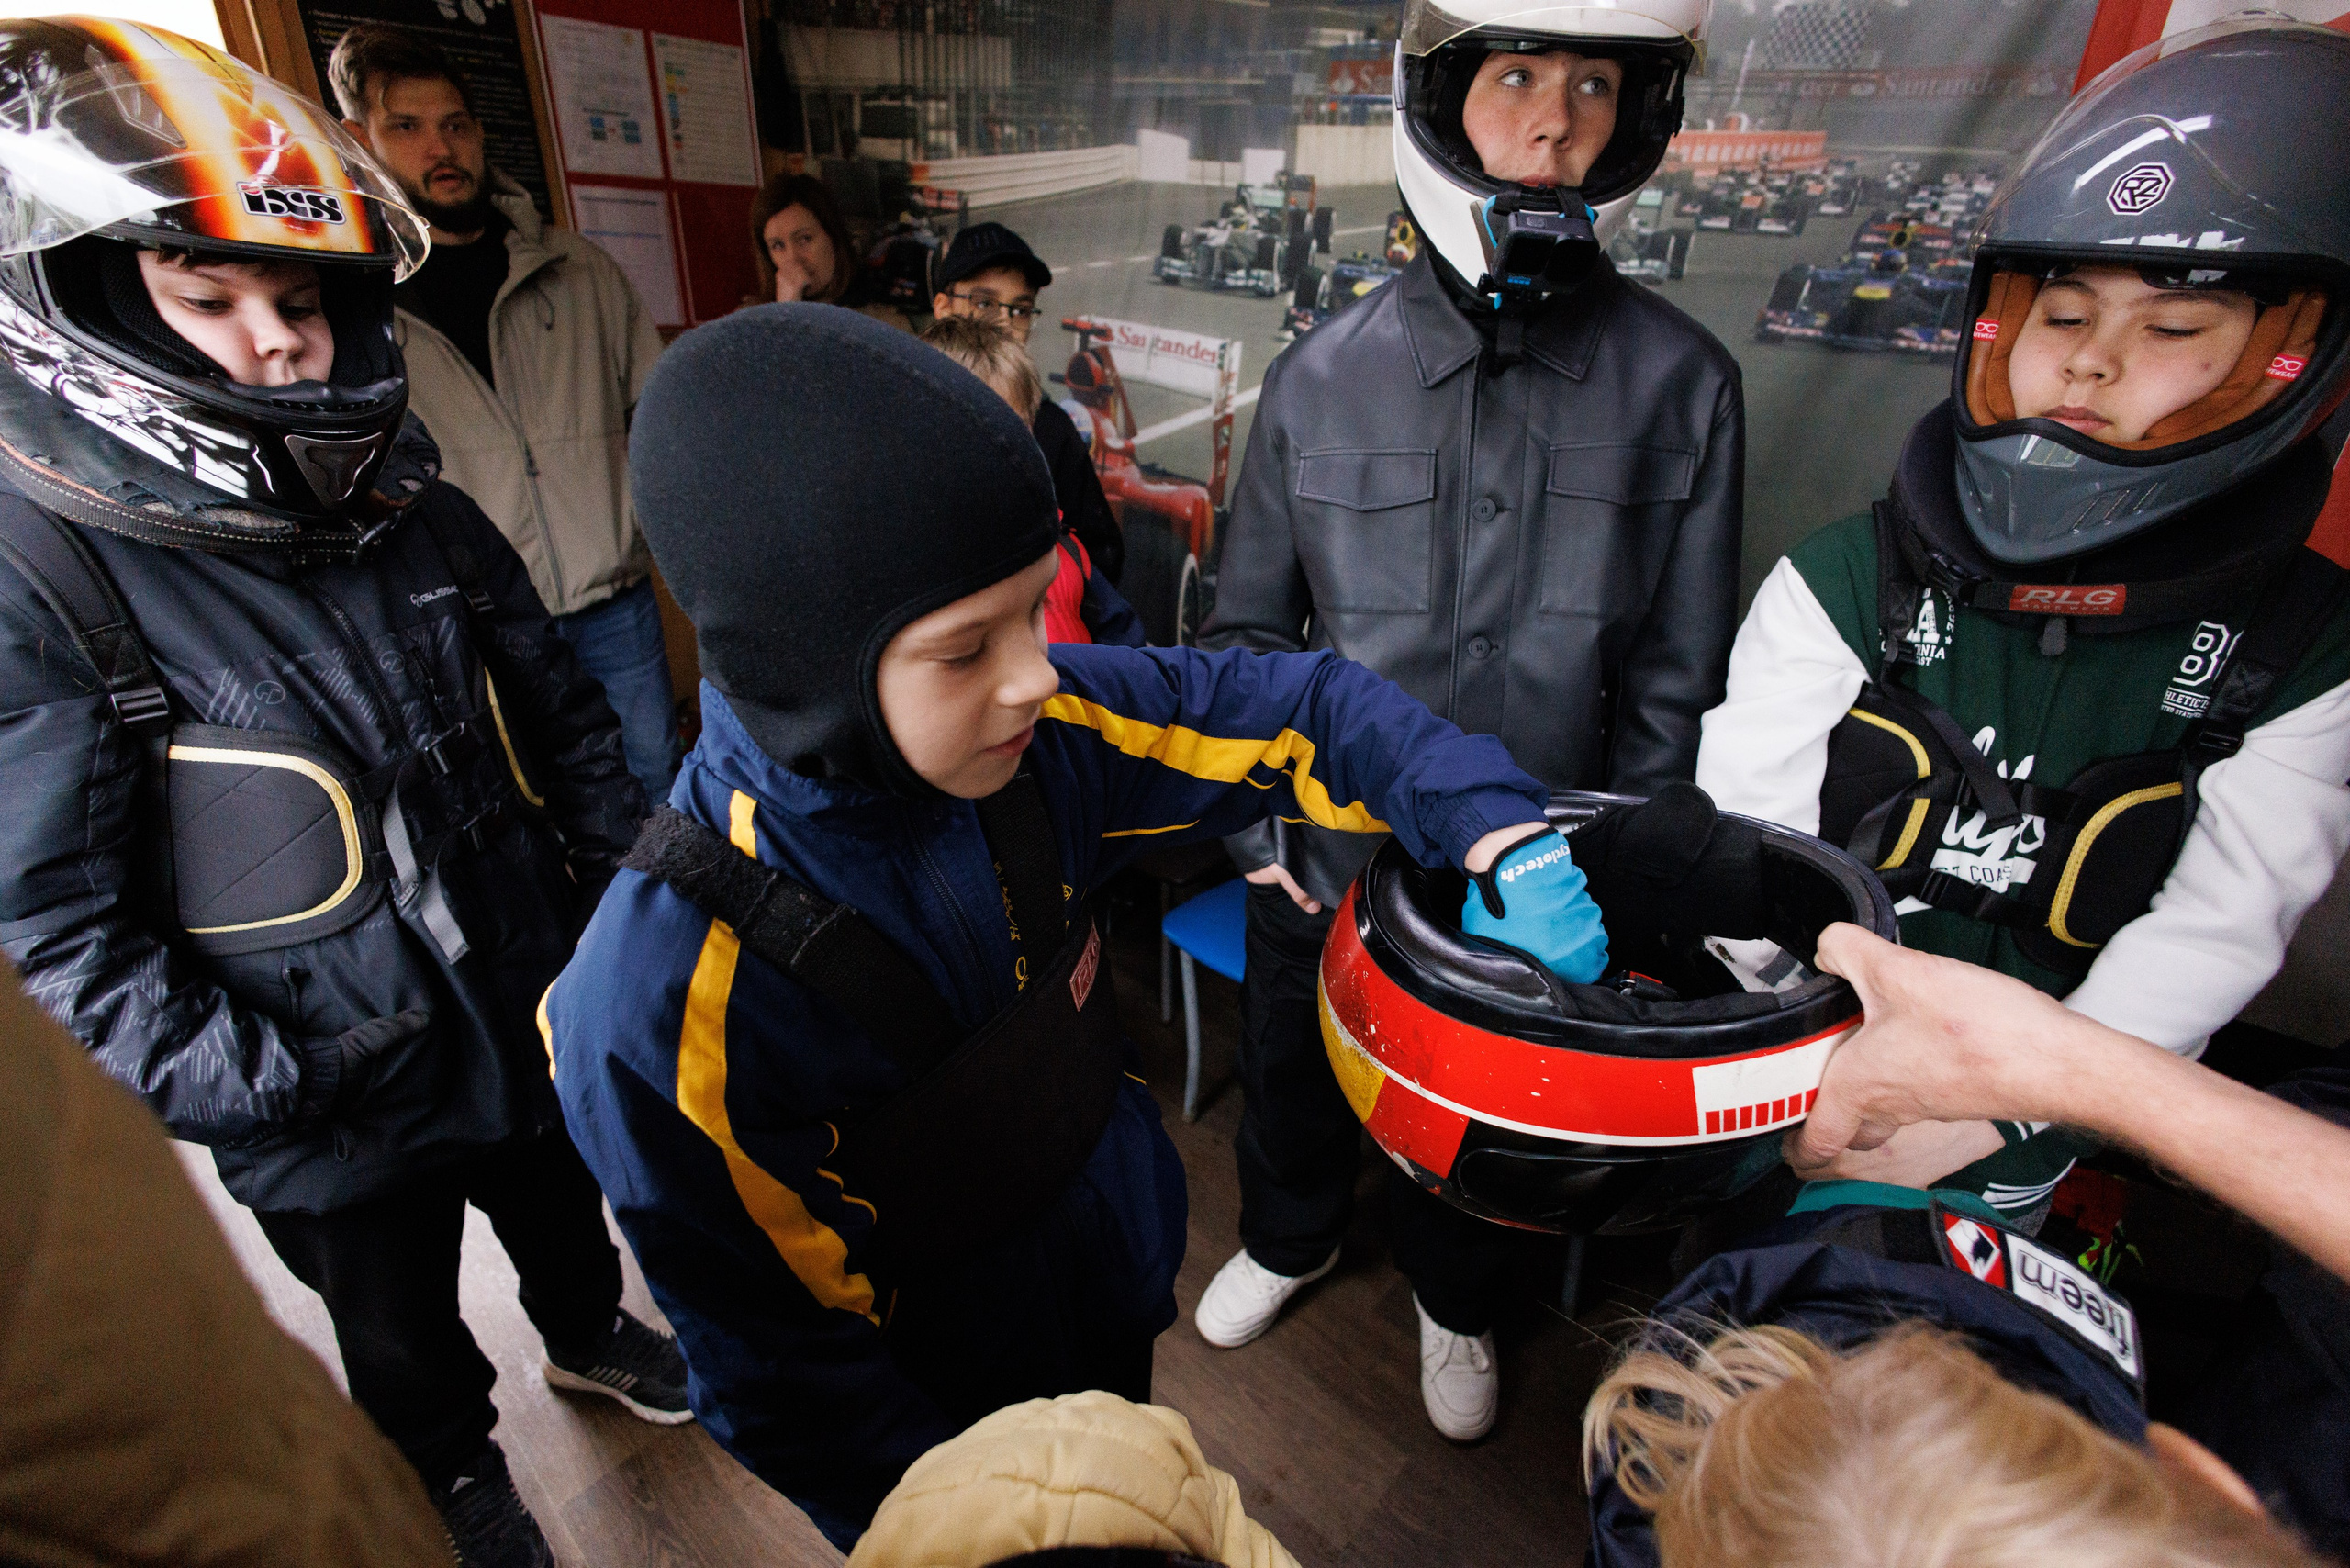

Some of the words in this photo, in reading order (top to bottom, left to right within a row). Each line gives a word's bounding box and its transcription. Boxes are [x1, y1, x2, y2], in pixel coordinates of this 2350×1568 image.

[2020, 589, 2117, 605] RLG
[1500, 843, 1571, 882] cyclotech
[2018, 1249, 2130, 1358] freem
